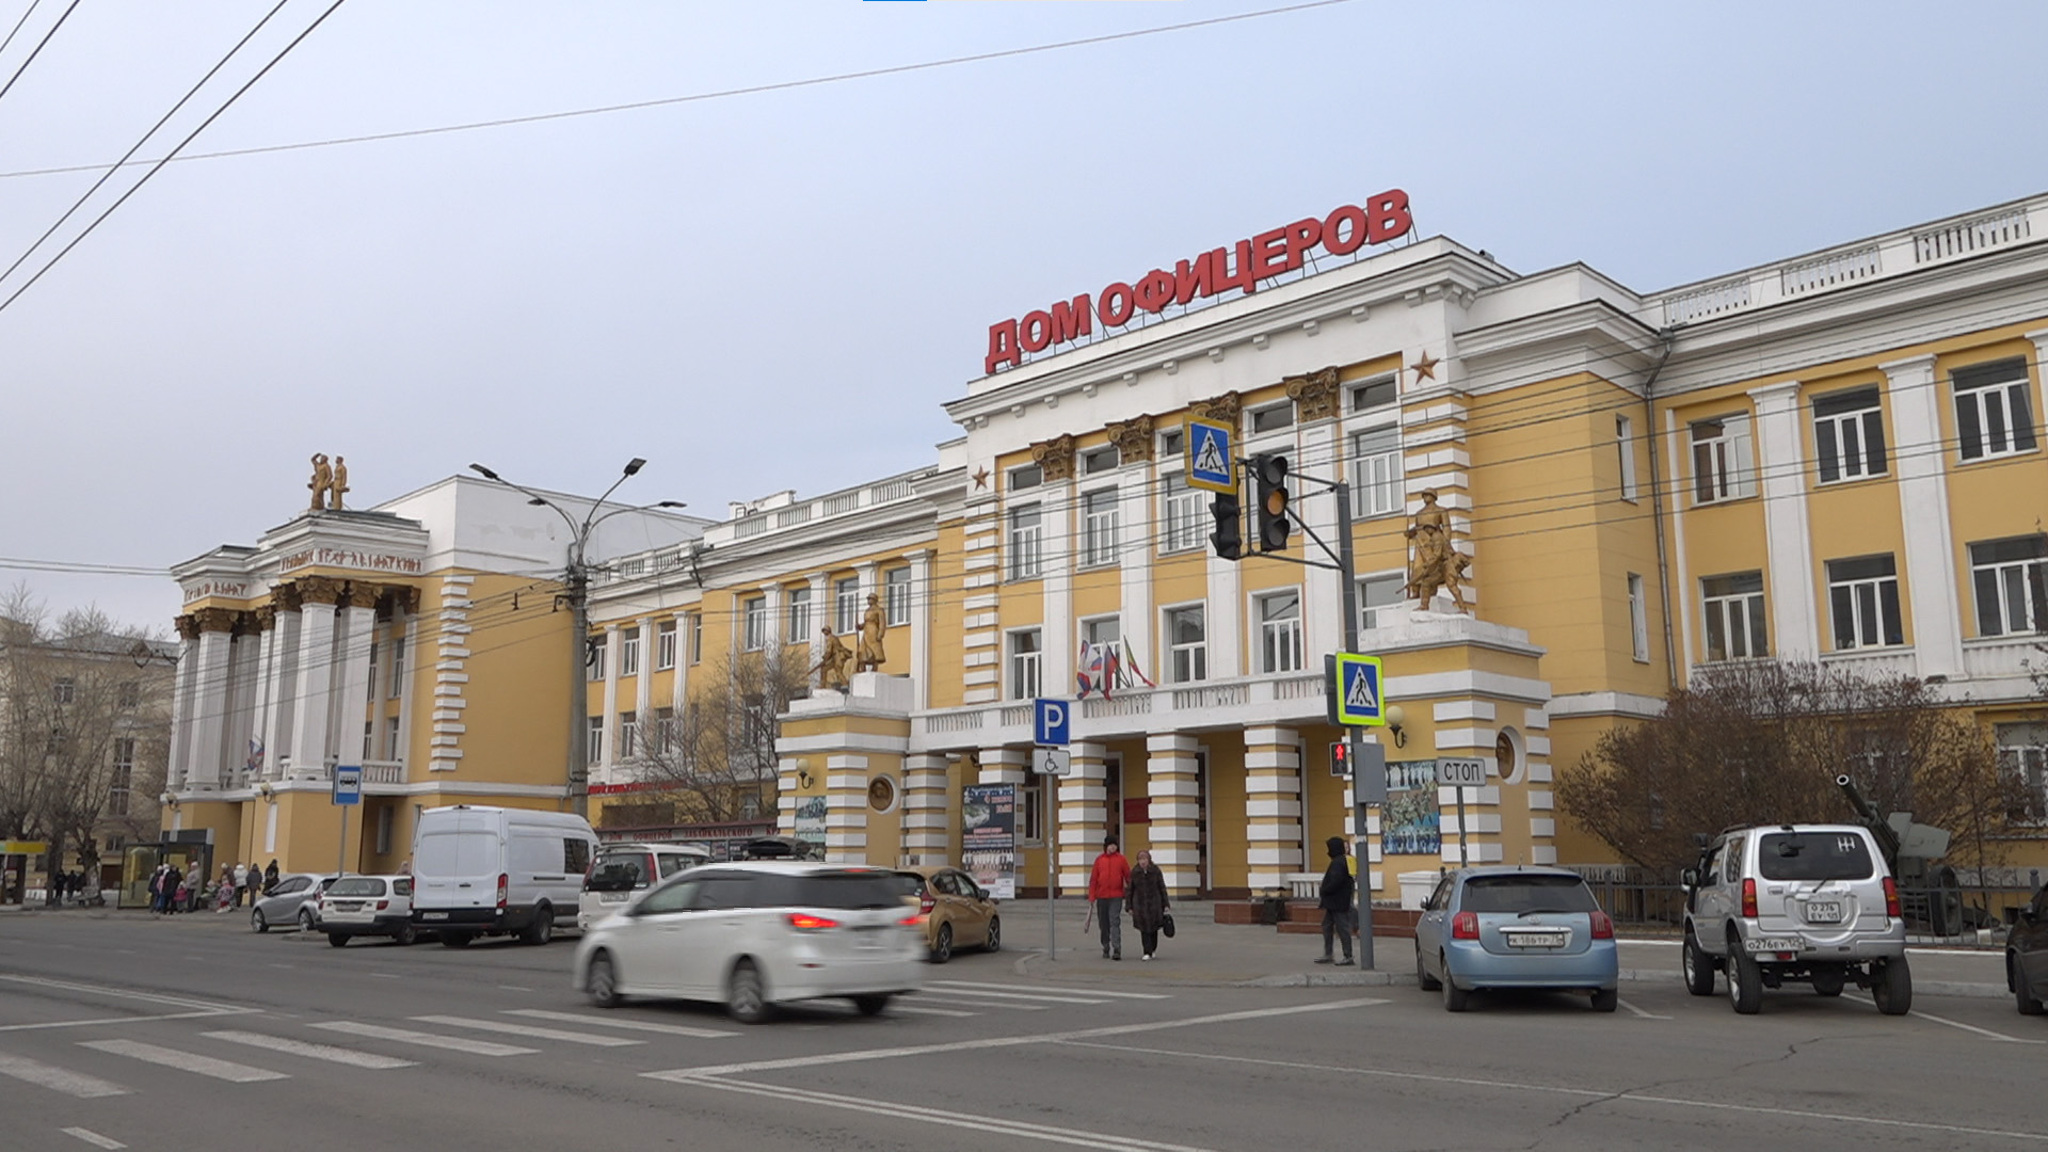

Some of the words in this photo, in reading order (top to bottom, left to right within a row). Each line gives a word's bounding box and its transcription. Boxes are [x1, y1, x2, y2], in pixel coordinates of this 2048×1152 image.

[985, 292, 1092, 374] ДОМ
[1098, 189, 1411, 327] ОФИЦЕРОВ
[1043, 703, 1063, 740] P
[1443, 762, 1480, 781] СТОП
